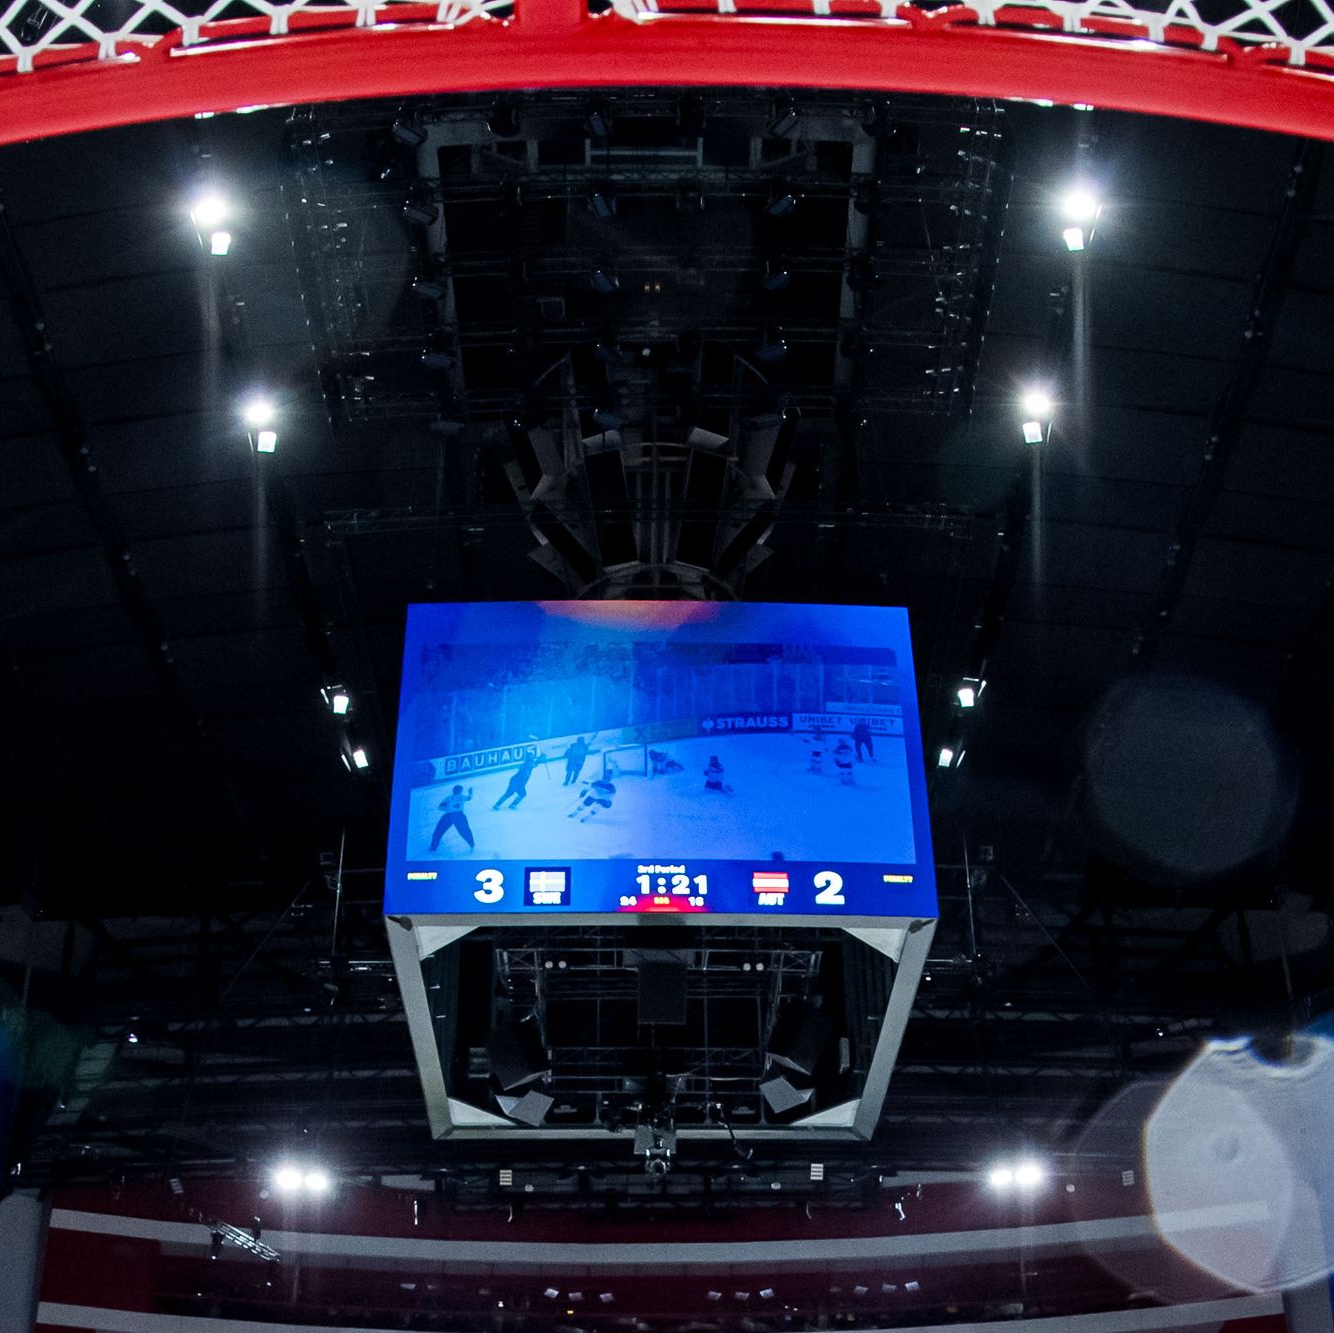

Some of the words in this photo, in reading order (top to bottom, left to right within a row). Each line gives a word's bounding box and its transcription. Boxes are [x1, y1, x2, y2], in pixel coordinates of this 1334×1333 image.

[716, 716, 789, 730] STRAUSS
[473, 868, 505, 904] 3
[636, 874, 708, 895] 1:21
[813, 870, 845, 905] 2
[758, 893, 785, 906] AUT
